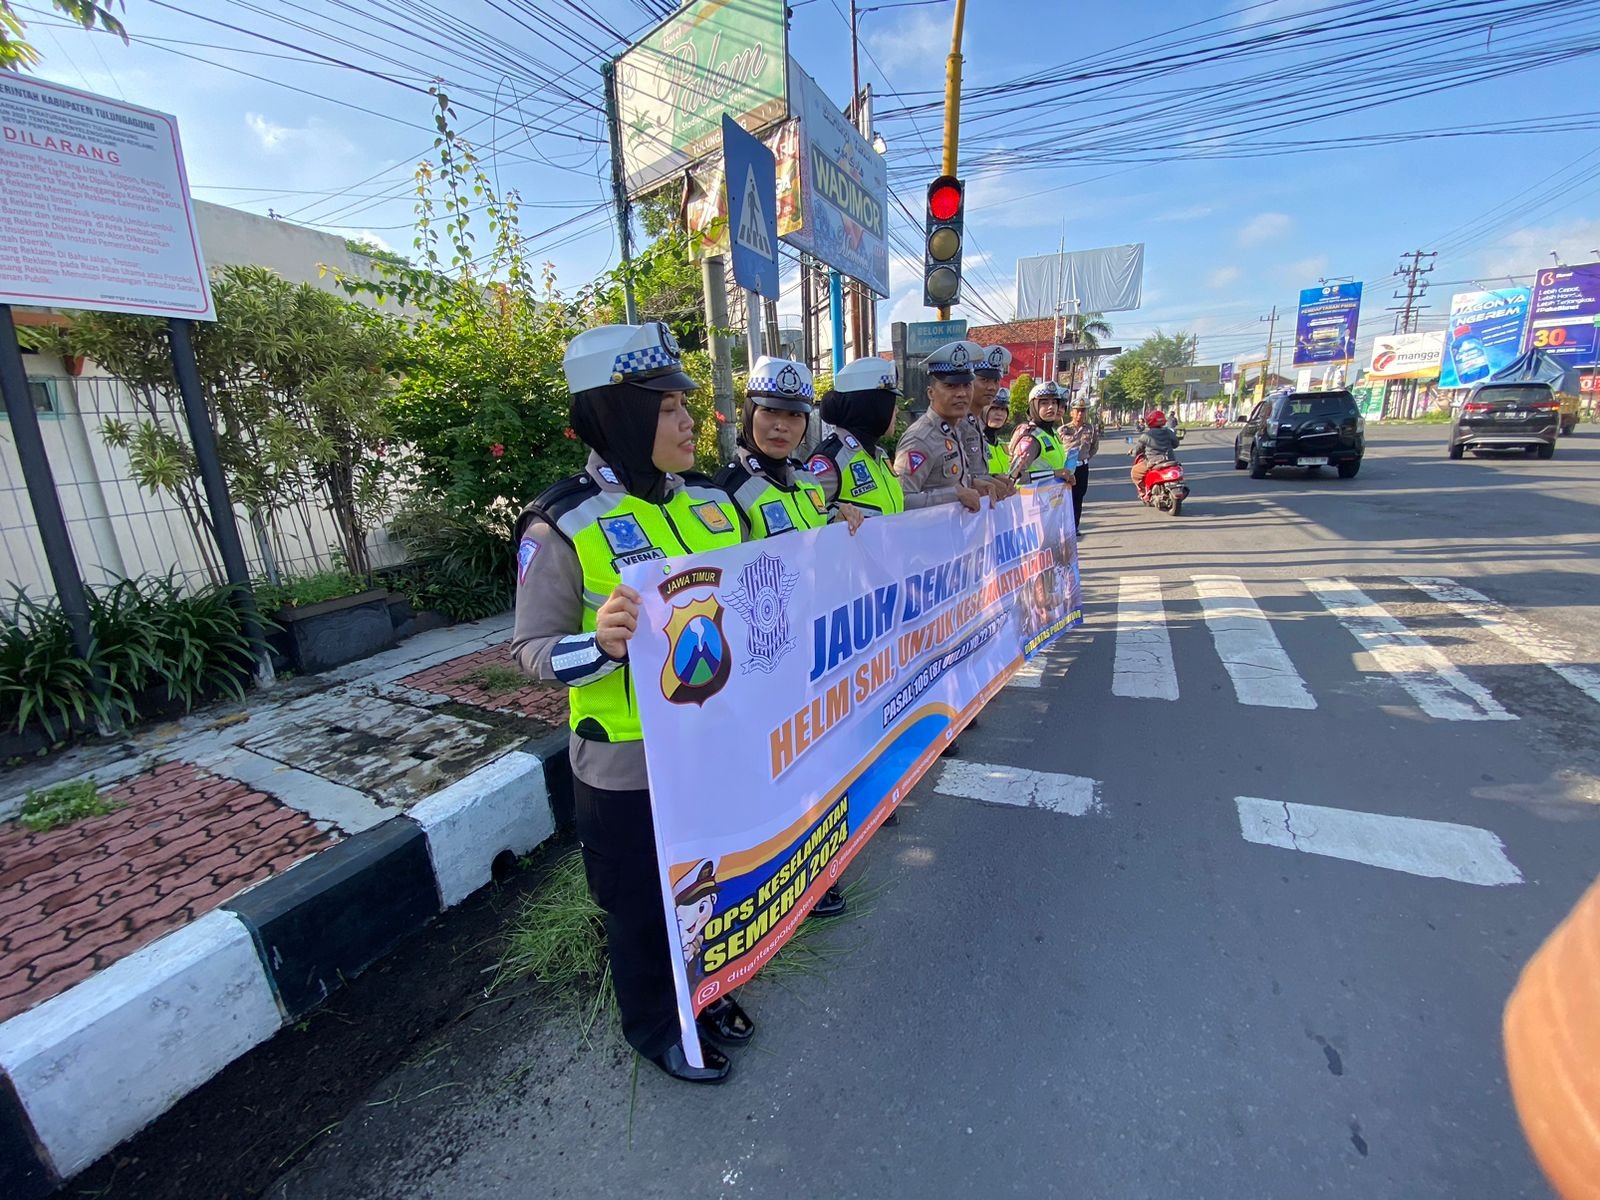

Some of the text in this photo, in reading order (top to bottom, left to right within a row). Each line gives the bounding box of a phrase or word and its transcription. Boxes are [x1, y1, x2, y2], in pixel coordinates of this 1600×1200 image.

[663, 27, 682, 48] Hotel
[650, 30, 768, 125] Palem
[41, 94, 93, 115] KABUPATEN
[95, 107, 155, 131] TULUNGAGUNG
[2, 125, 120, 164] DILARANG
[36, 155, 58, 166] Pada
[813, 148, 881, 235] WADIMOR
[1455, 294, 1526, 316] JAGONYA
[1456, 306, 1520, 326] NGEREM
[917, 325, 945, 336] BELOK
[1534, 328, 1567, 347] 30
[1397, 351, 1440, 363] mangga
[622, 551, 660, 566] VEENA
[666, 571, 717, 595] JAWA TIMUR
[810, 581, 898, 682] JAUH
[902, 554, 973, 623] DEKAT
[973, 521, 1039, 582] GUAKAN
[770, 676, 849, 780] HELM
[855, 647, 896, 703] SNI,
[900, 607, 954, 666] UNTUK
[883, 681, 914, 728] PASAL
[914, 670, 929, 698] 106
[705, 796, 848, 940] OPS KESELAMATAN
[704, 820, 848, 972] SEMERU 2024
